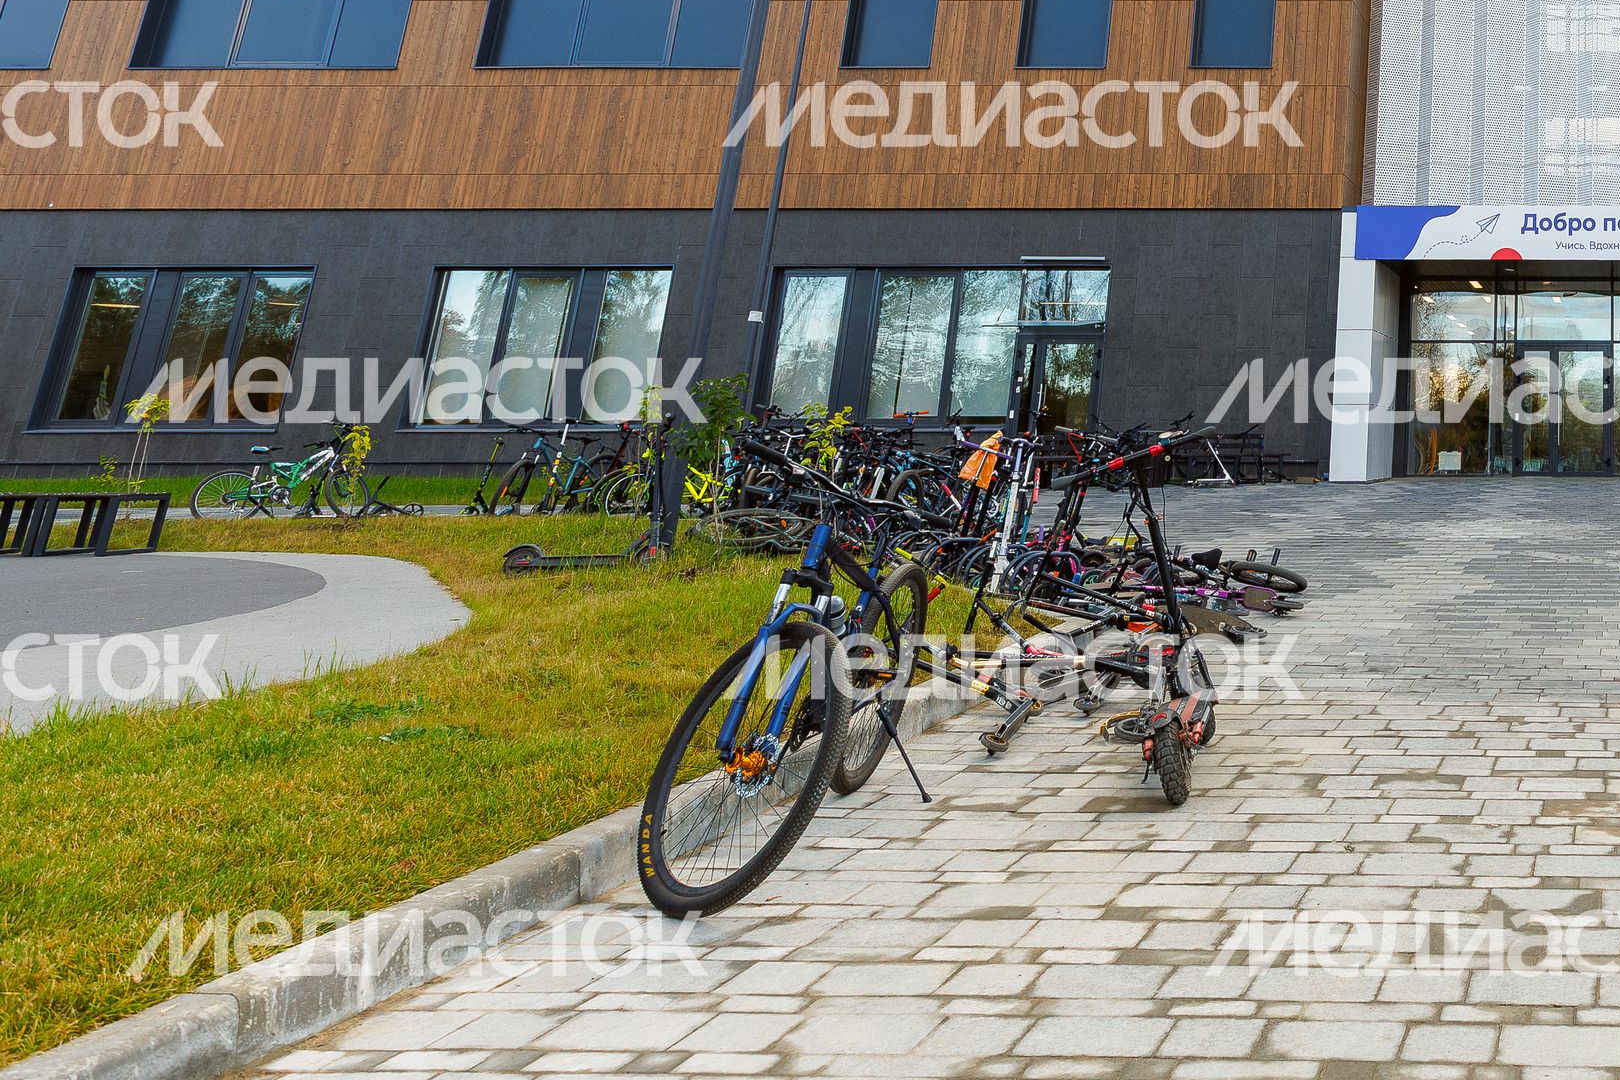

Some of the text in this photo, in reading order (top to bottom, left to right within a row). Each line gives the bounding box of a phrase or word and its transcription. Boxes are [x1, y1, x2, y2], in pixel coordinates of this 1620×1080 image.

[1521, 212, 1596, 236] Добро
[1555, 241, 1587, 250] Учись.
[641, 813, 656, 878] WANDA
